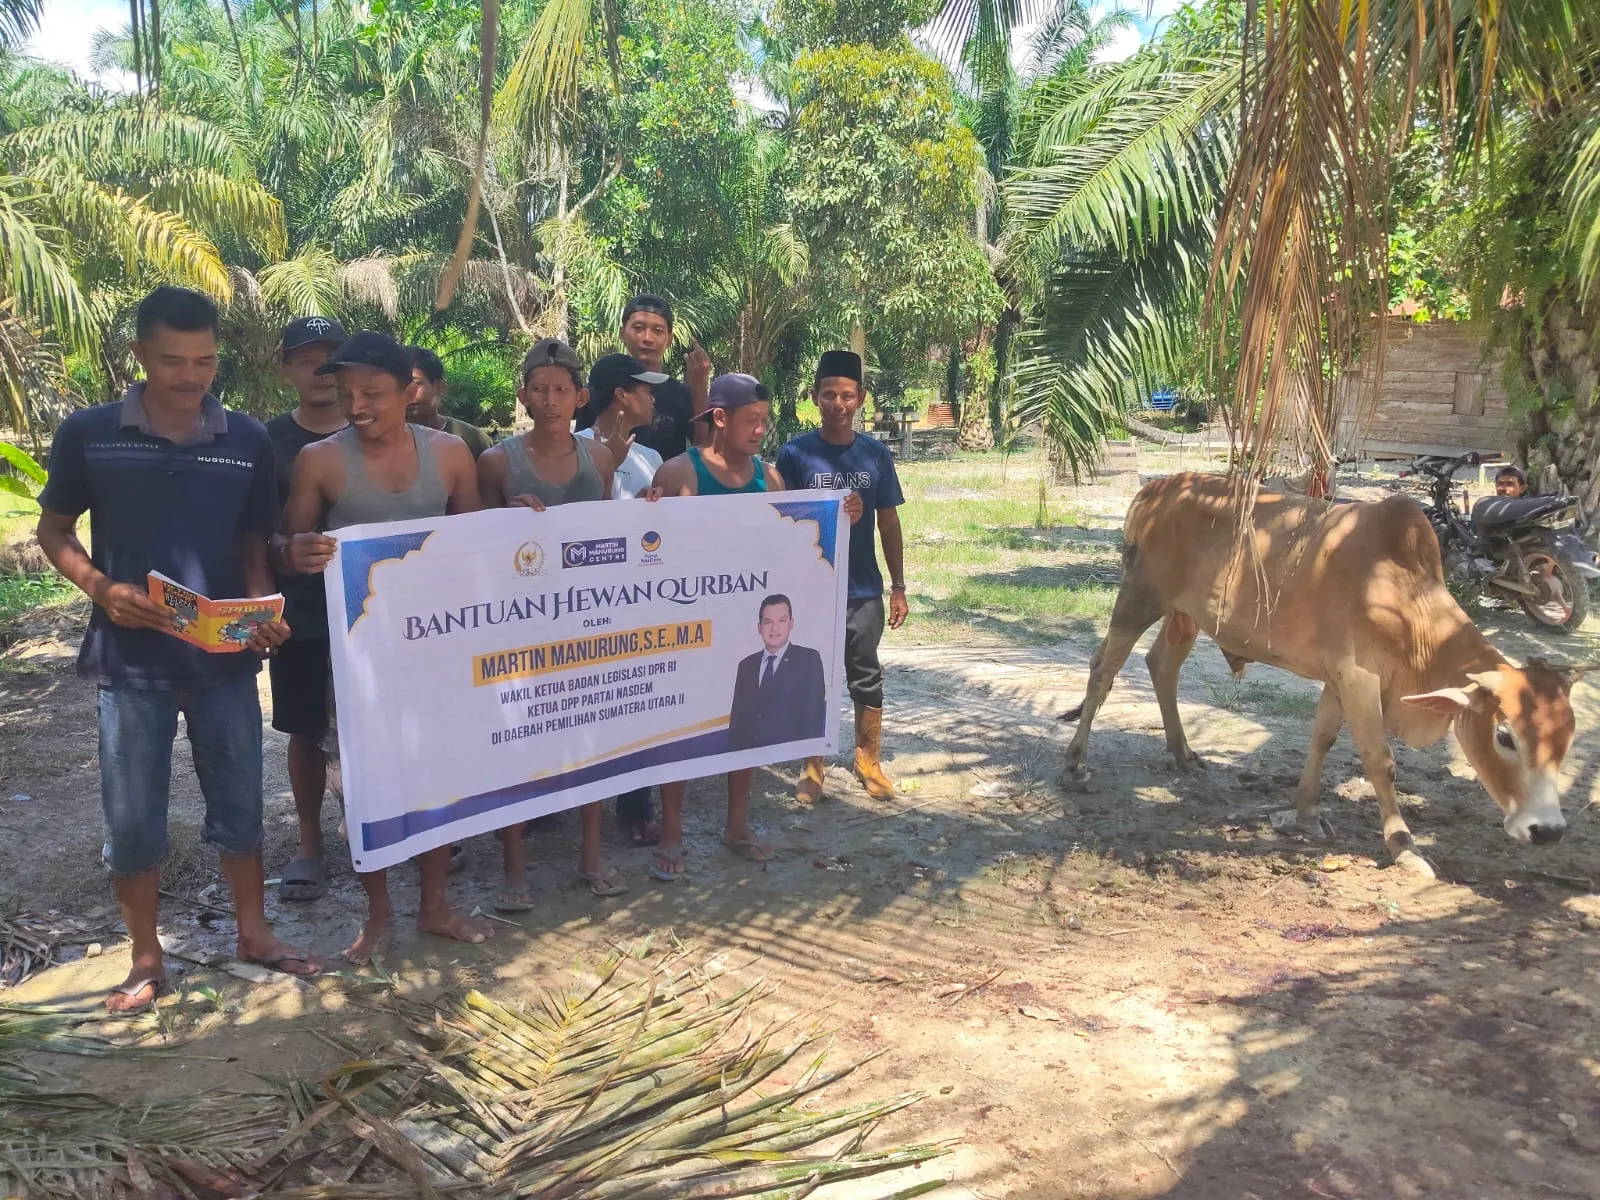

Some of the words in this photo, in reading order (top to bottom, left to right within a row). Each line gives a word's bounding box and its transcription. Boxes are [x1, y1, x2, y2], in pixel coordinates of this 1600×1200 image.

[809, 472, 870, 489] JEANS
[588, 548, 624, 556] MANURUNG
[589, 554, 625, 563] CENTRE
[402, 595, 546, 641] BANTUAN
[552, 581, 652, 620] HEWAN
[656, 571, 769, 605] QURBAN
[582, 617, 612, 628] OLEH:
[481, 647, 546, 680] MARTIN
[500, 686, 532, 705] WAKIL
[535, 682, 566, 698] KETUA
[568, 674, 600, 693] BADAN
[602, 667, 646, 686] LEGISLASI
[648, 662, 666, 676] DPR
[668, 660, 677, 673] RI
[528, 701, 558, 718] KETUA
[562, 697, 580, 712] DPP
[582, 690, 614, 708] PARTAI
[616, 682, 653, 700] NASDEM
[492, 731, 502, 745] DI
[504, 722, 543, 742] DAERAH
[546, 711, 596, 734] PEMILIHAN
[598, 702, 646, 722] SUMATERA
[648, 696, 677, 711] UTARA
[678, 692, 684, 705] II
